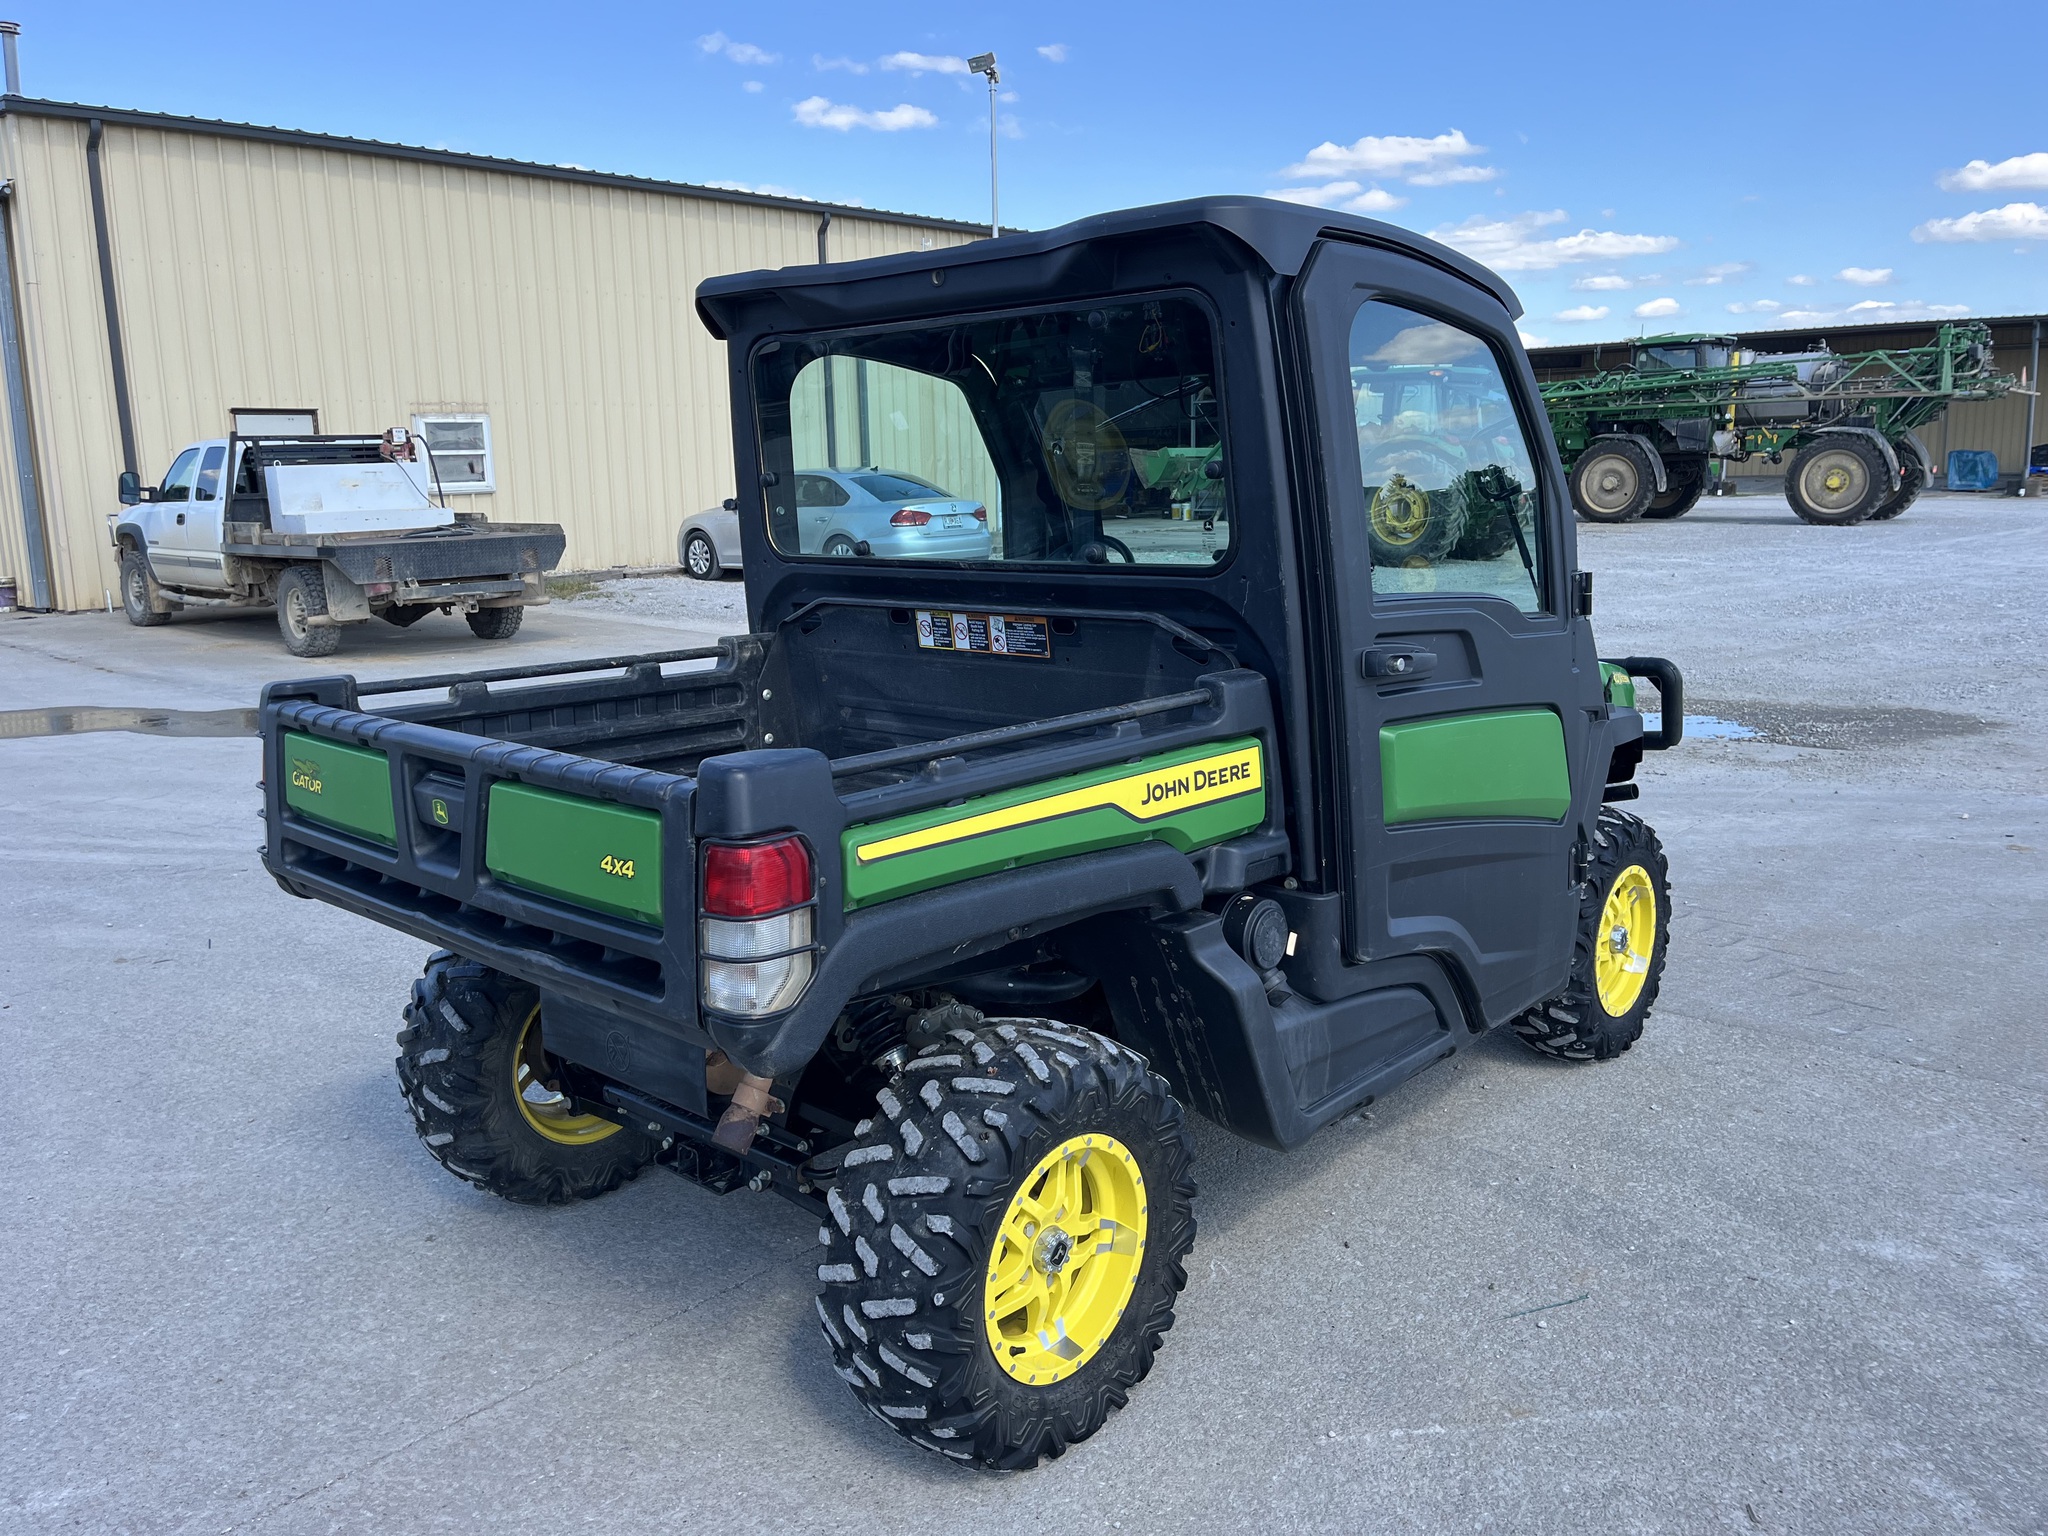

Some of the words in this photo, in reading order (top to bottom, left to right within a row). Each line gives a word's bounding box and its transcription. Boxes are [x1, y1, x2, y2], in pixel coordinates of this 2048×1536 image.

[292, 770, 322, 795] GATOR
[1141, 777, 1189, 805] JOHN
[1194, 761, 1250, 791] DEERE
